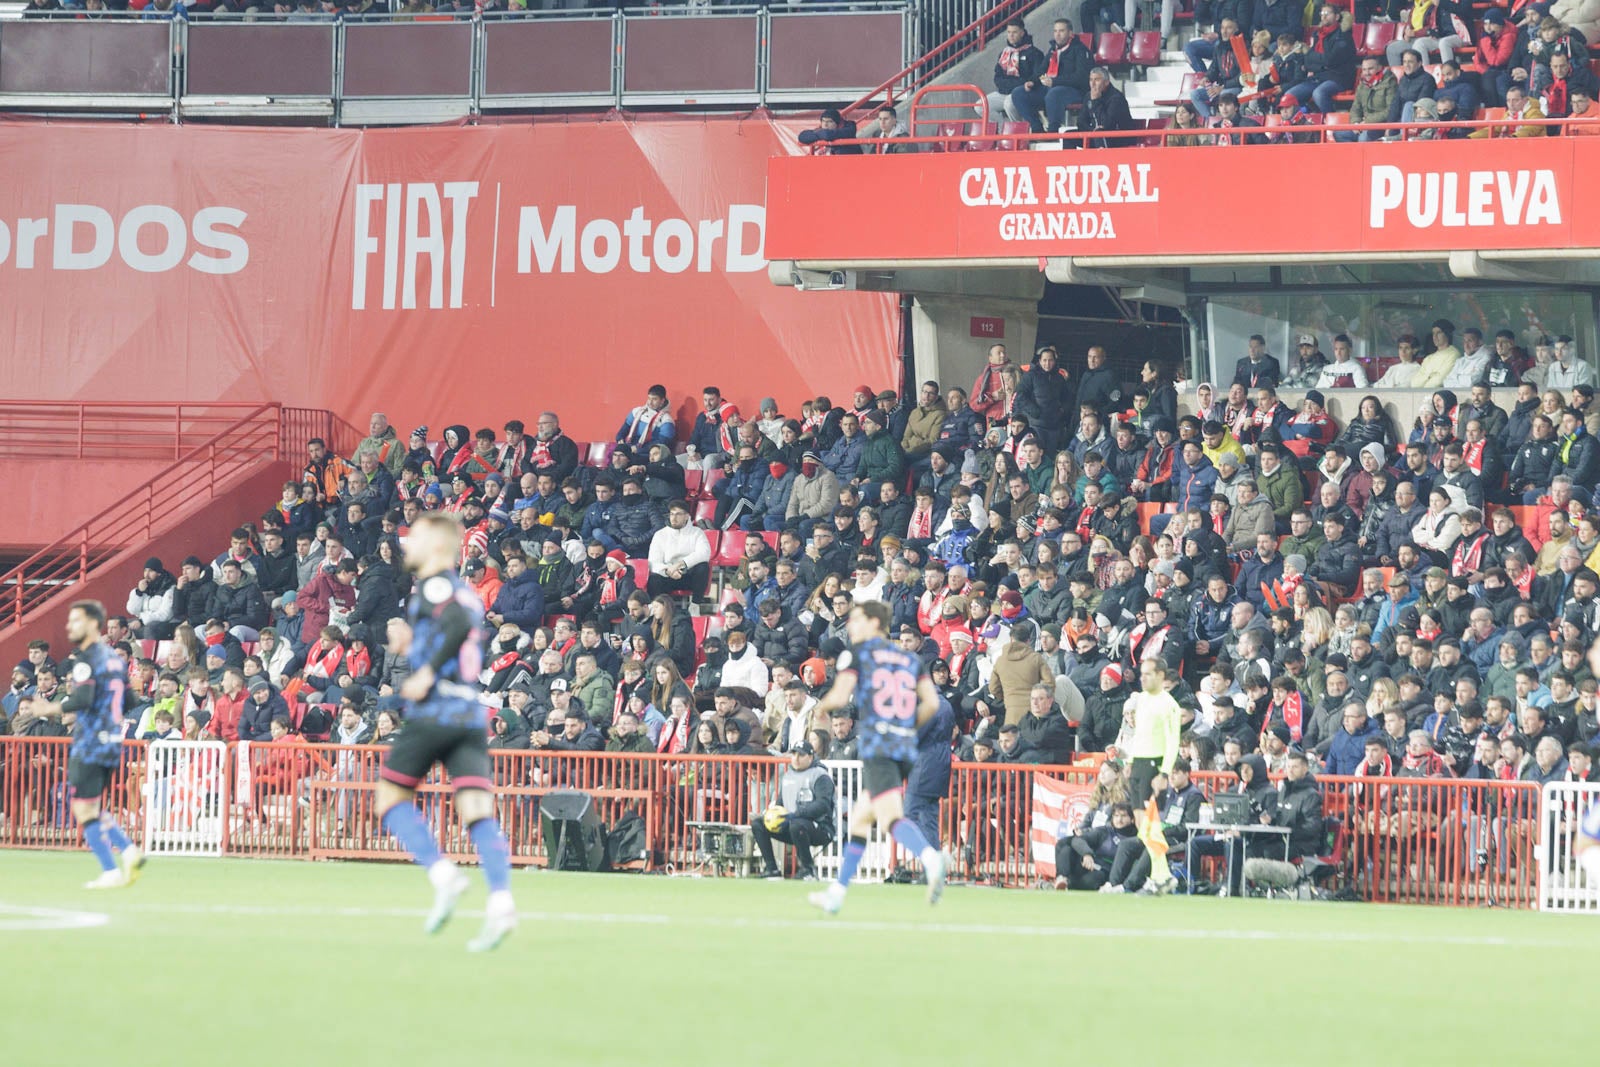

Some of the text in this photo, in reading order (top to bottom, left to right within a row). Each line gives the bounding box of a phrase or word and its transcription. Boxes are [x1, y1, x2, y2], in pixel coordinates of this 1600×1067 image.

[959, 163, 1159, 208] CAJA RURAL
[1370, 165, 1562, 228] PULEVA
[0, 203, 250, 275] rDOS
[352, 181, 479, 310] FIAT
[999, 211, 1116, 241] GRANADA
[981, 323, 994, 332] 112
[109, 678, 125, 724] 7
[871, 667, 917, 720] 26
